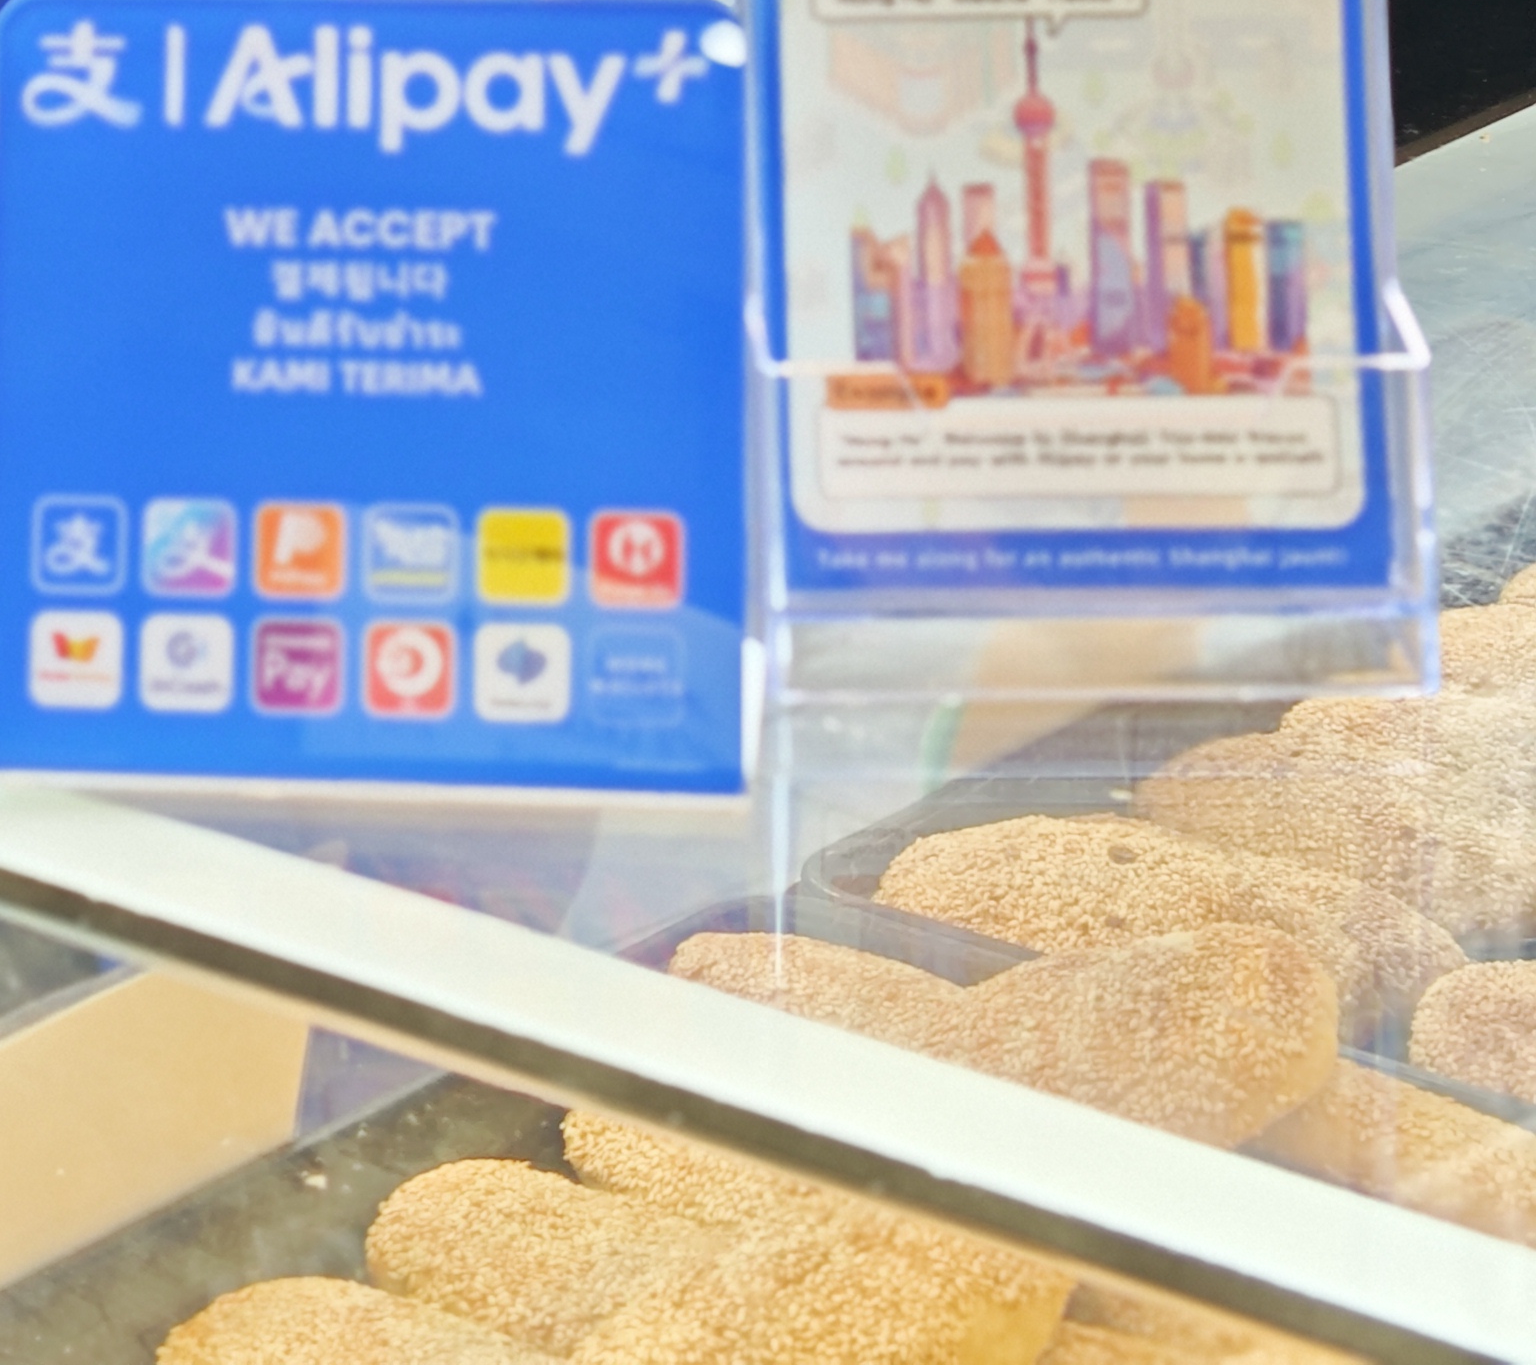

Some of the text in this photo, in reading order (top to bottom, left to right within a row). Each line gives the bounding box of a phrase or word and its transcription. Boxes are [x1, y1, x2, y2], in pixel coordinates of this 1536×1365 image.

[204, 23, 711, 157] Alipay+
[224, 206, 497, 253] WE ACCEPT
[231, 358, 483, 397] KAMI TERIMA
